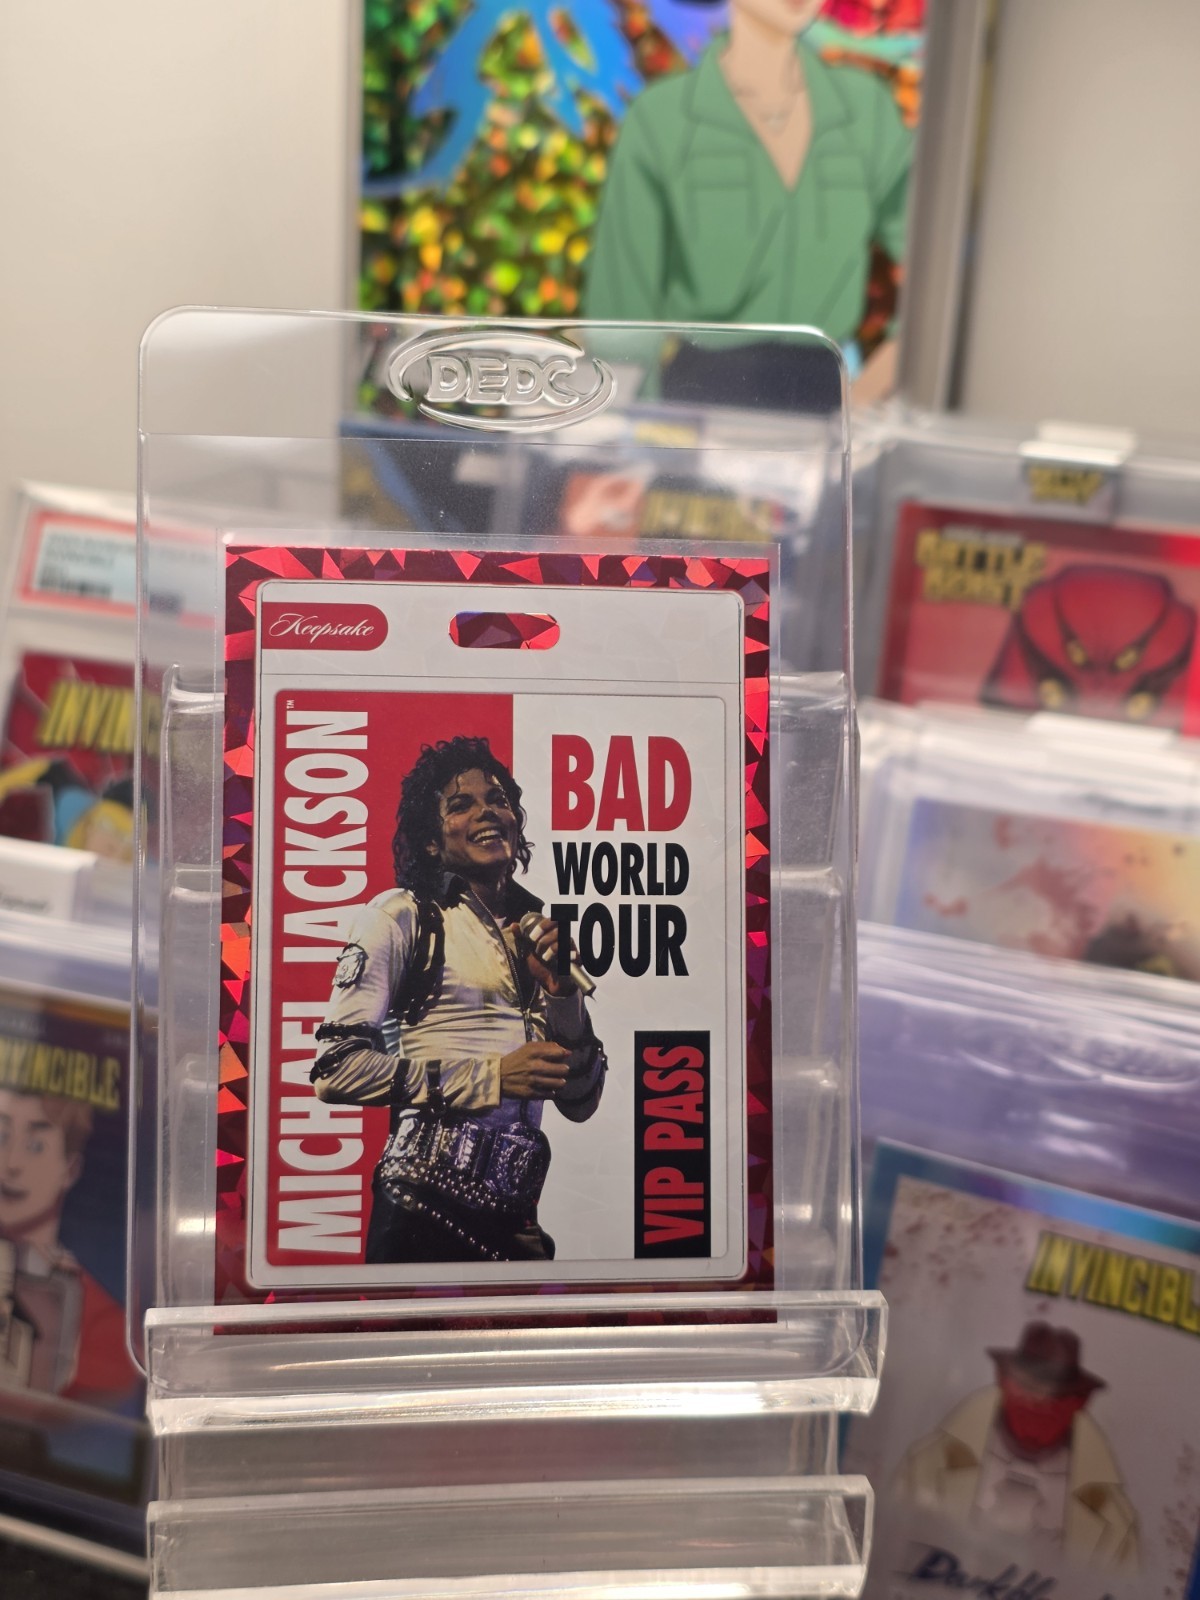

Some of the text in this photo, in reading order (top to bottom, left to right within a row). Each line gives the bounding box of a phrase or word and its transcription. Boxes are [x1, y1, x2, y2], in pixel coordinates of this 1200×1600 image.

[427, 356, 580, 406] DEDC
[268, 612, 376, 644] Keepsake
[551, 734, 692, 832] BAD
[282, 710, 369, 963] JACKSON
[552, 841, 690, 896] WORLD
[550, 902, 690, 978] TOUR
[642, 1045, 705, 1245] VIP PASS
